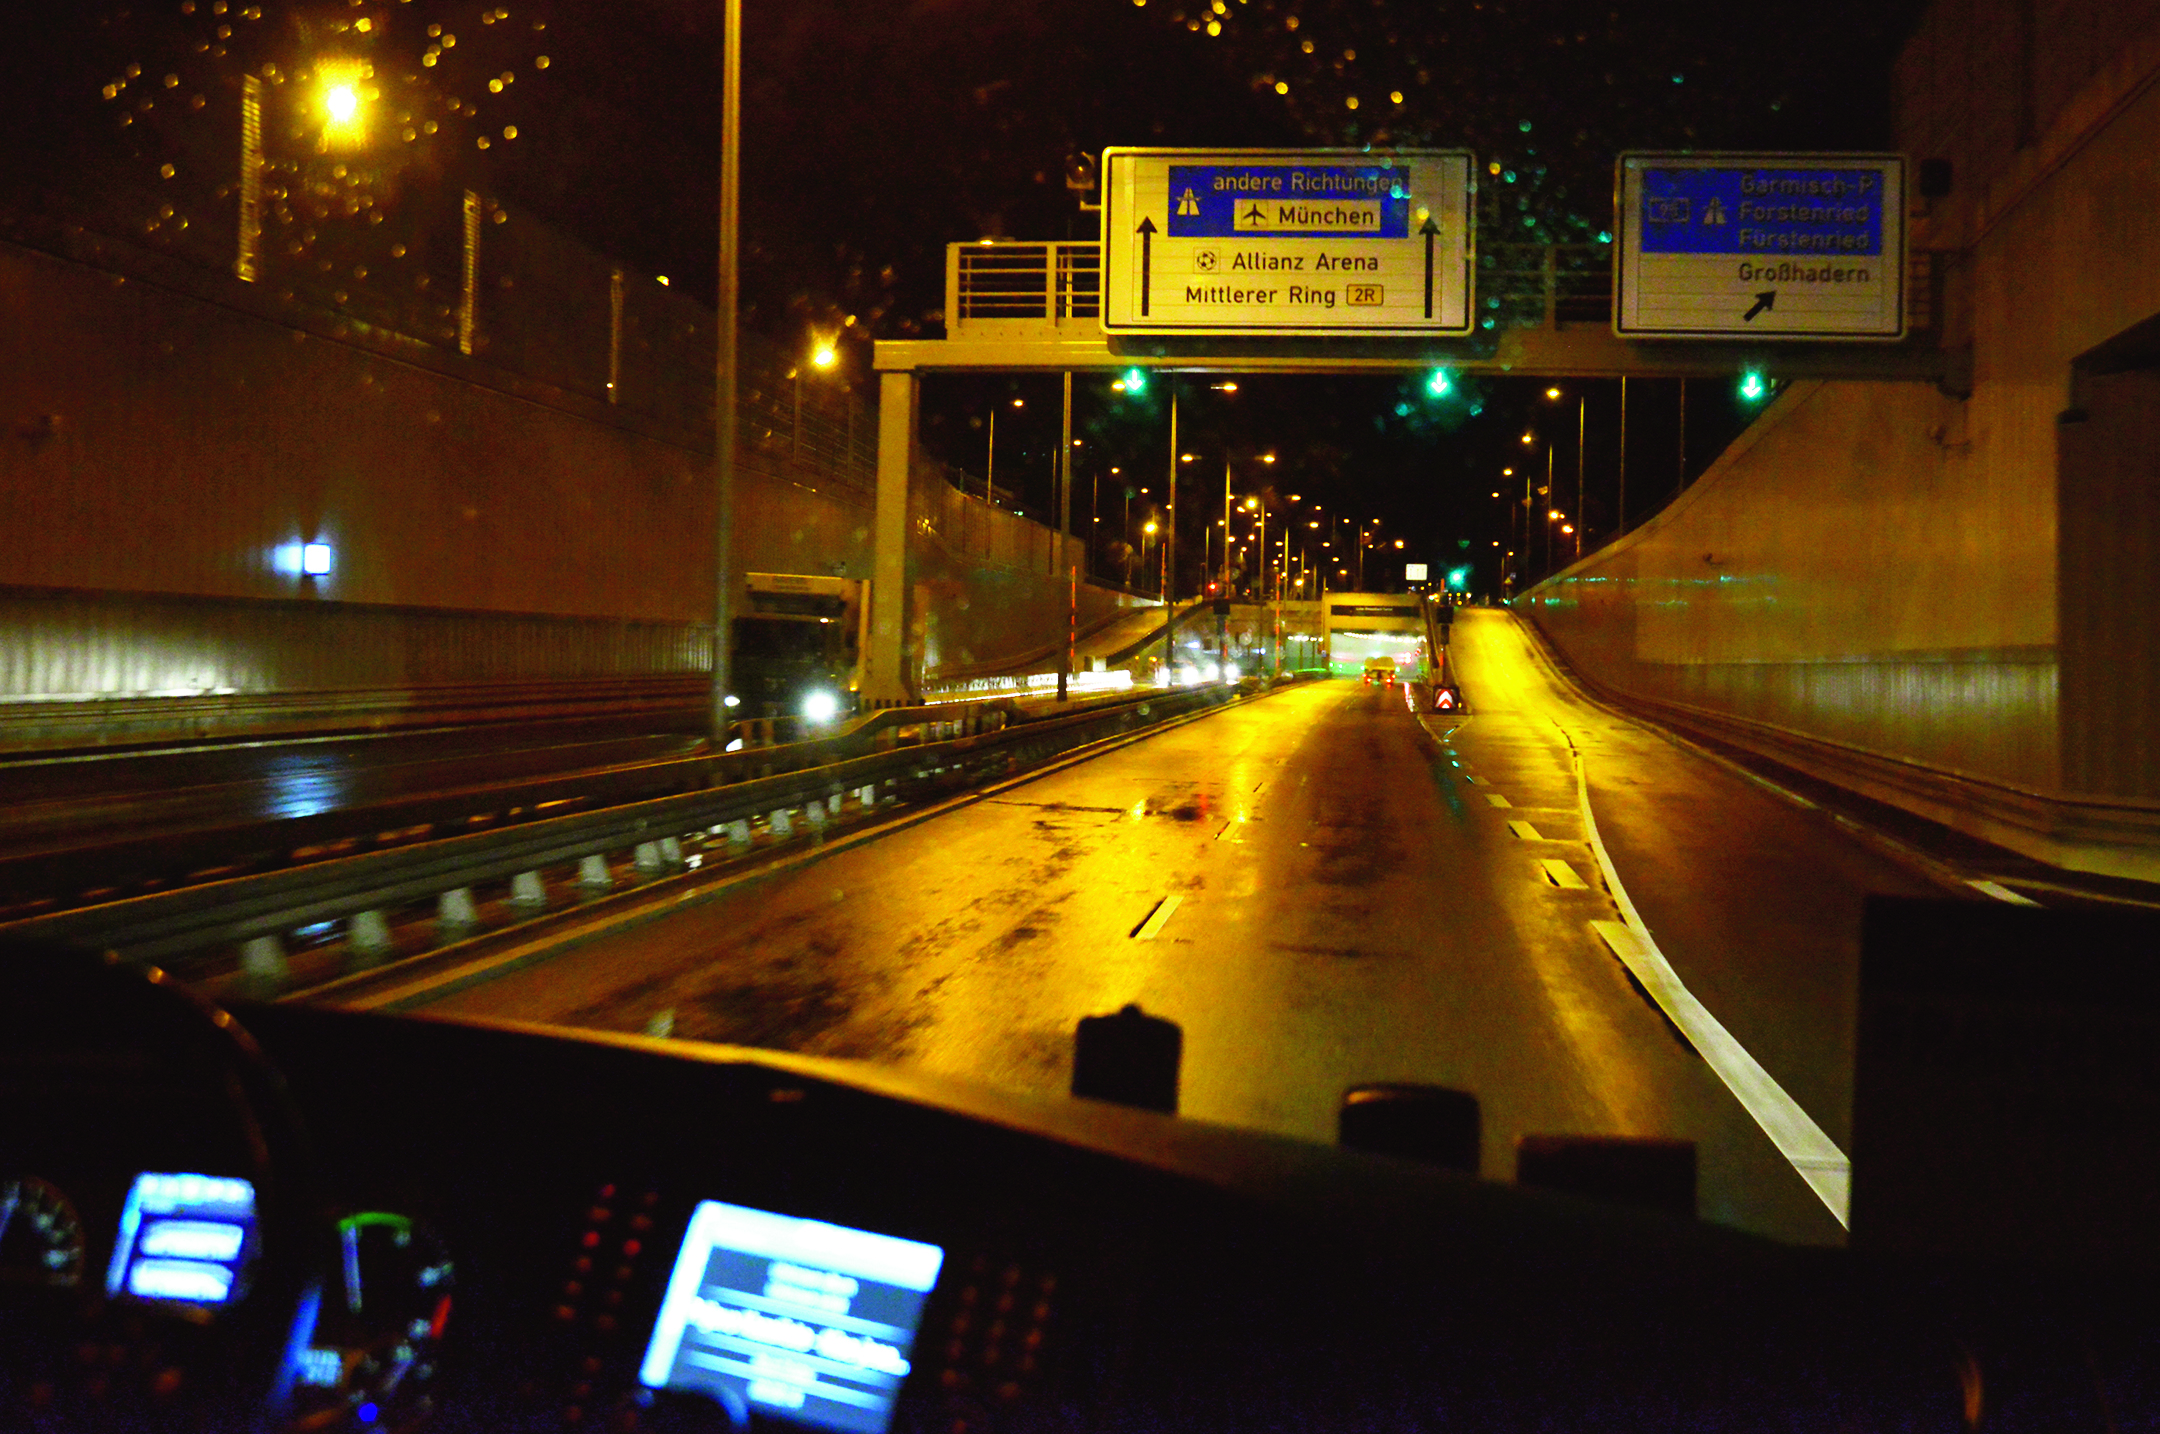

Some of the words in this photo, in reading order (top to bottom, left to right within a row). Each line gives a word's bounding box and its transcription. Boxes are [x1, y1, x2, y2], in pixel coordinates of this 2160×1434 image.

[1213, 172, 1282, 191] andere
[1291, 172, 1403, 197] Richtungen
[1740, 174, 1874, 195] Garmisch-P
[1279, 206, 1375, 225] München
[1739, 201, 1870, 222] Forstenried
[1739, 228, 1870, 248] Fürstenried
[1232, 252, 1304, 271] Allianz
[1316, 252, 1379, 271] Arena
[1738, 262, 1871, 283] Großhadern
[1185, 286, 1278, 304] Mittlerer
[1289, 286, 1336, 309] Ring
[1354, 288, 1376, 303] 2R
